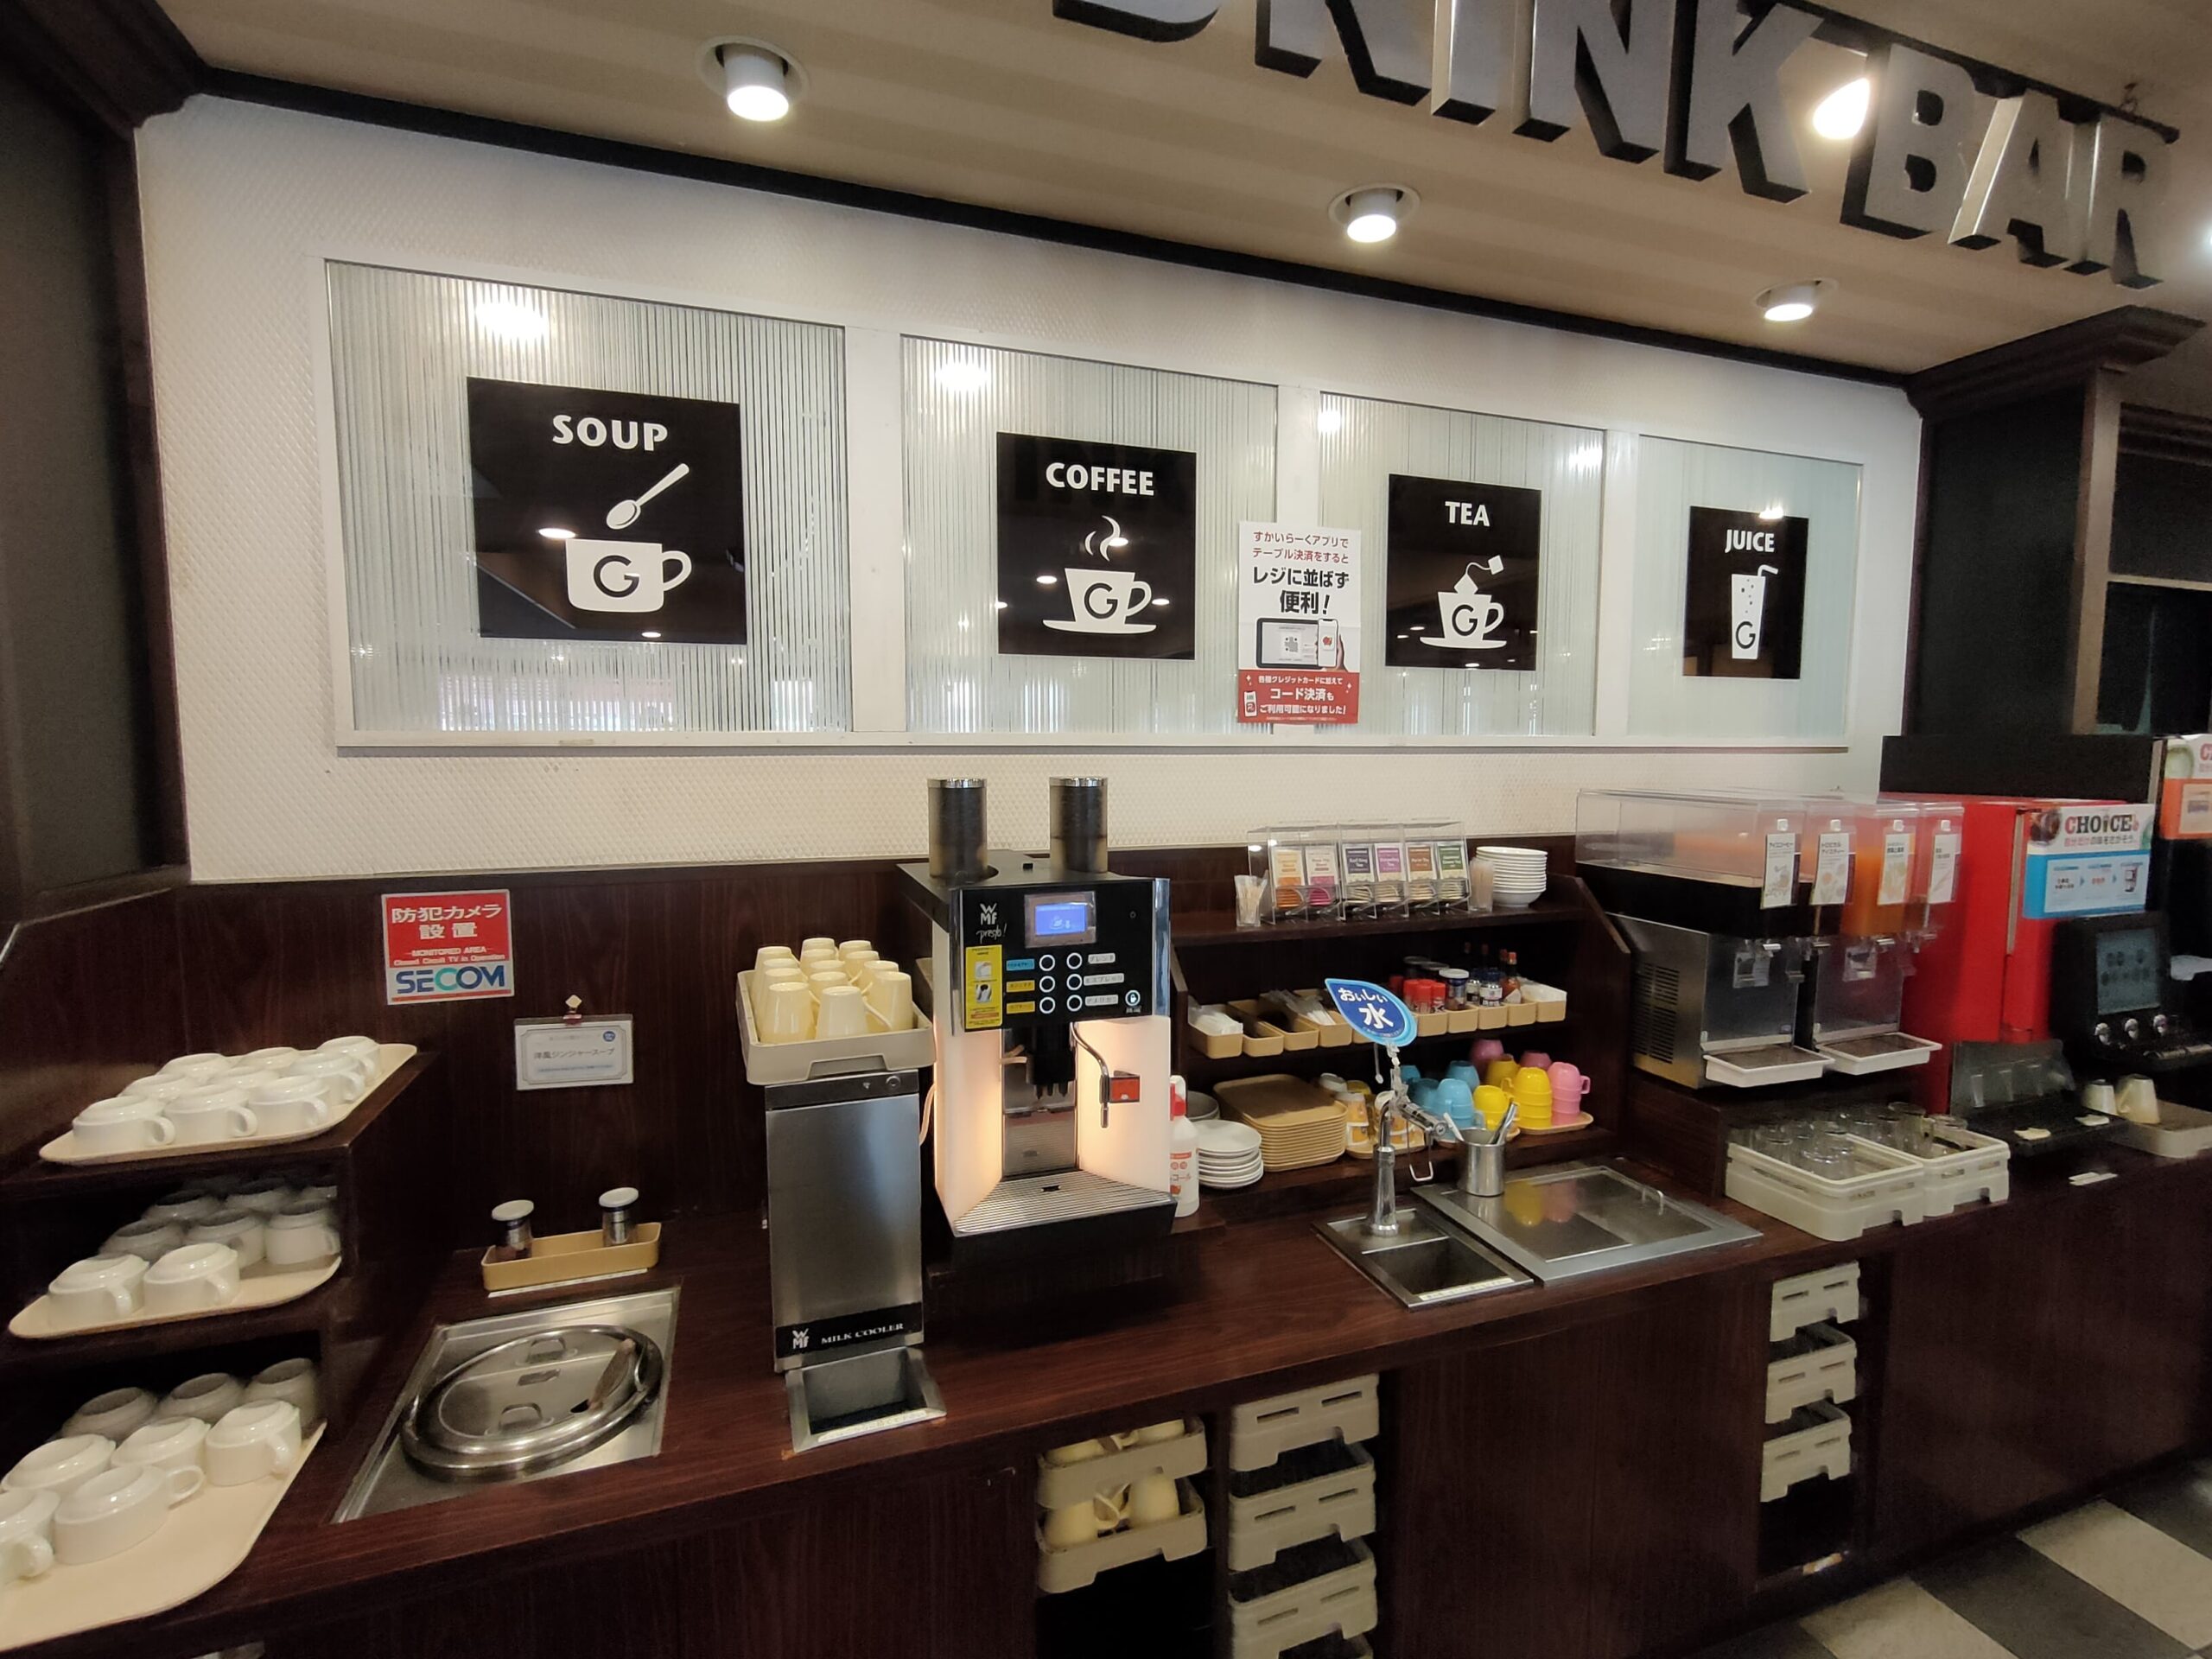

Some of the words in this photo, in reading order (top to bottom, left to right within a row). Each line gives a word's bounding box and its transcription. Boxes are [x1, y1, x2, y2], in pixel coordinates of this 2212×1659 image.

[1055, 0, 1826, 203] INK
[1840, 43, 2167, 289] BAR
[552, 415, 668, 451] SOUP
[1046, 462, 1154, 496] COFFEE
[1445, 500, 1491, 527] TEA
[1253, 531, 1349, 548] すかいらーくアプリで
[1725, 529, 1775, 553] JUICE
[1253, 548, 1349, 564] テーブル決済をすると
[593, 555, 640, 598] G
[1253, 566, 1350, 588] レジに並ばず
[1084, 582, 1119, 620] G
[1452, 604, 1478, 636] G
[1735, 620, 1756, 649] G
[1270, 687, 1334, 702] コード決済も
[391, 904, 503, 924] 防犯カメラ
[980, 903, 998, 925] WMF
[419, 922, 478, 940] 設置
[396, 964, 505, 994] SECOM
[1338, 988, 1389, 1003] おいしい
[1358, 1003, 1395, 1029] 水
[791, 1328, 810, 1350] WMF
[821, 1332, 853, 1344] MILK
[855, 1323, 905, 1338] COOLER
